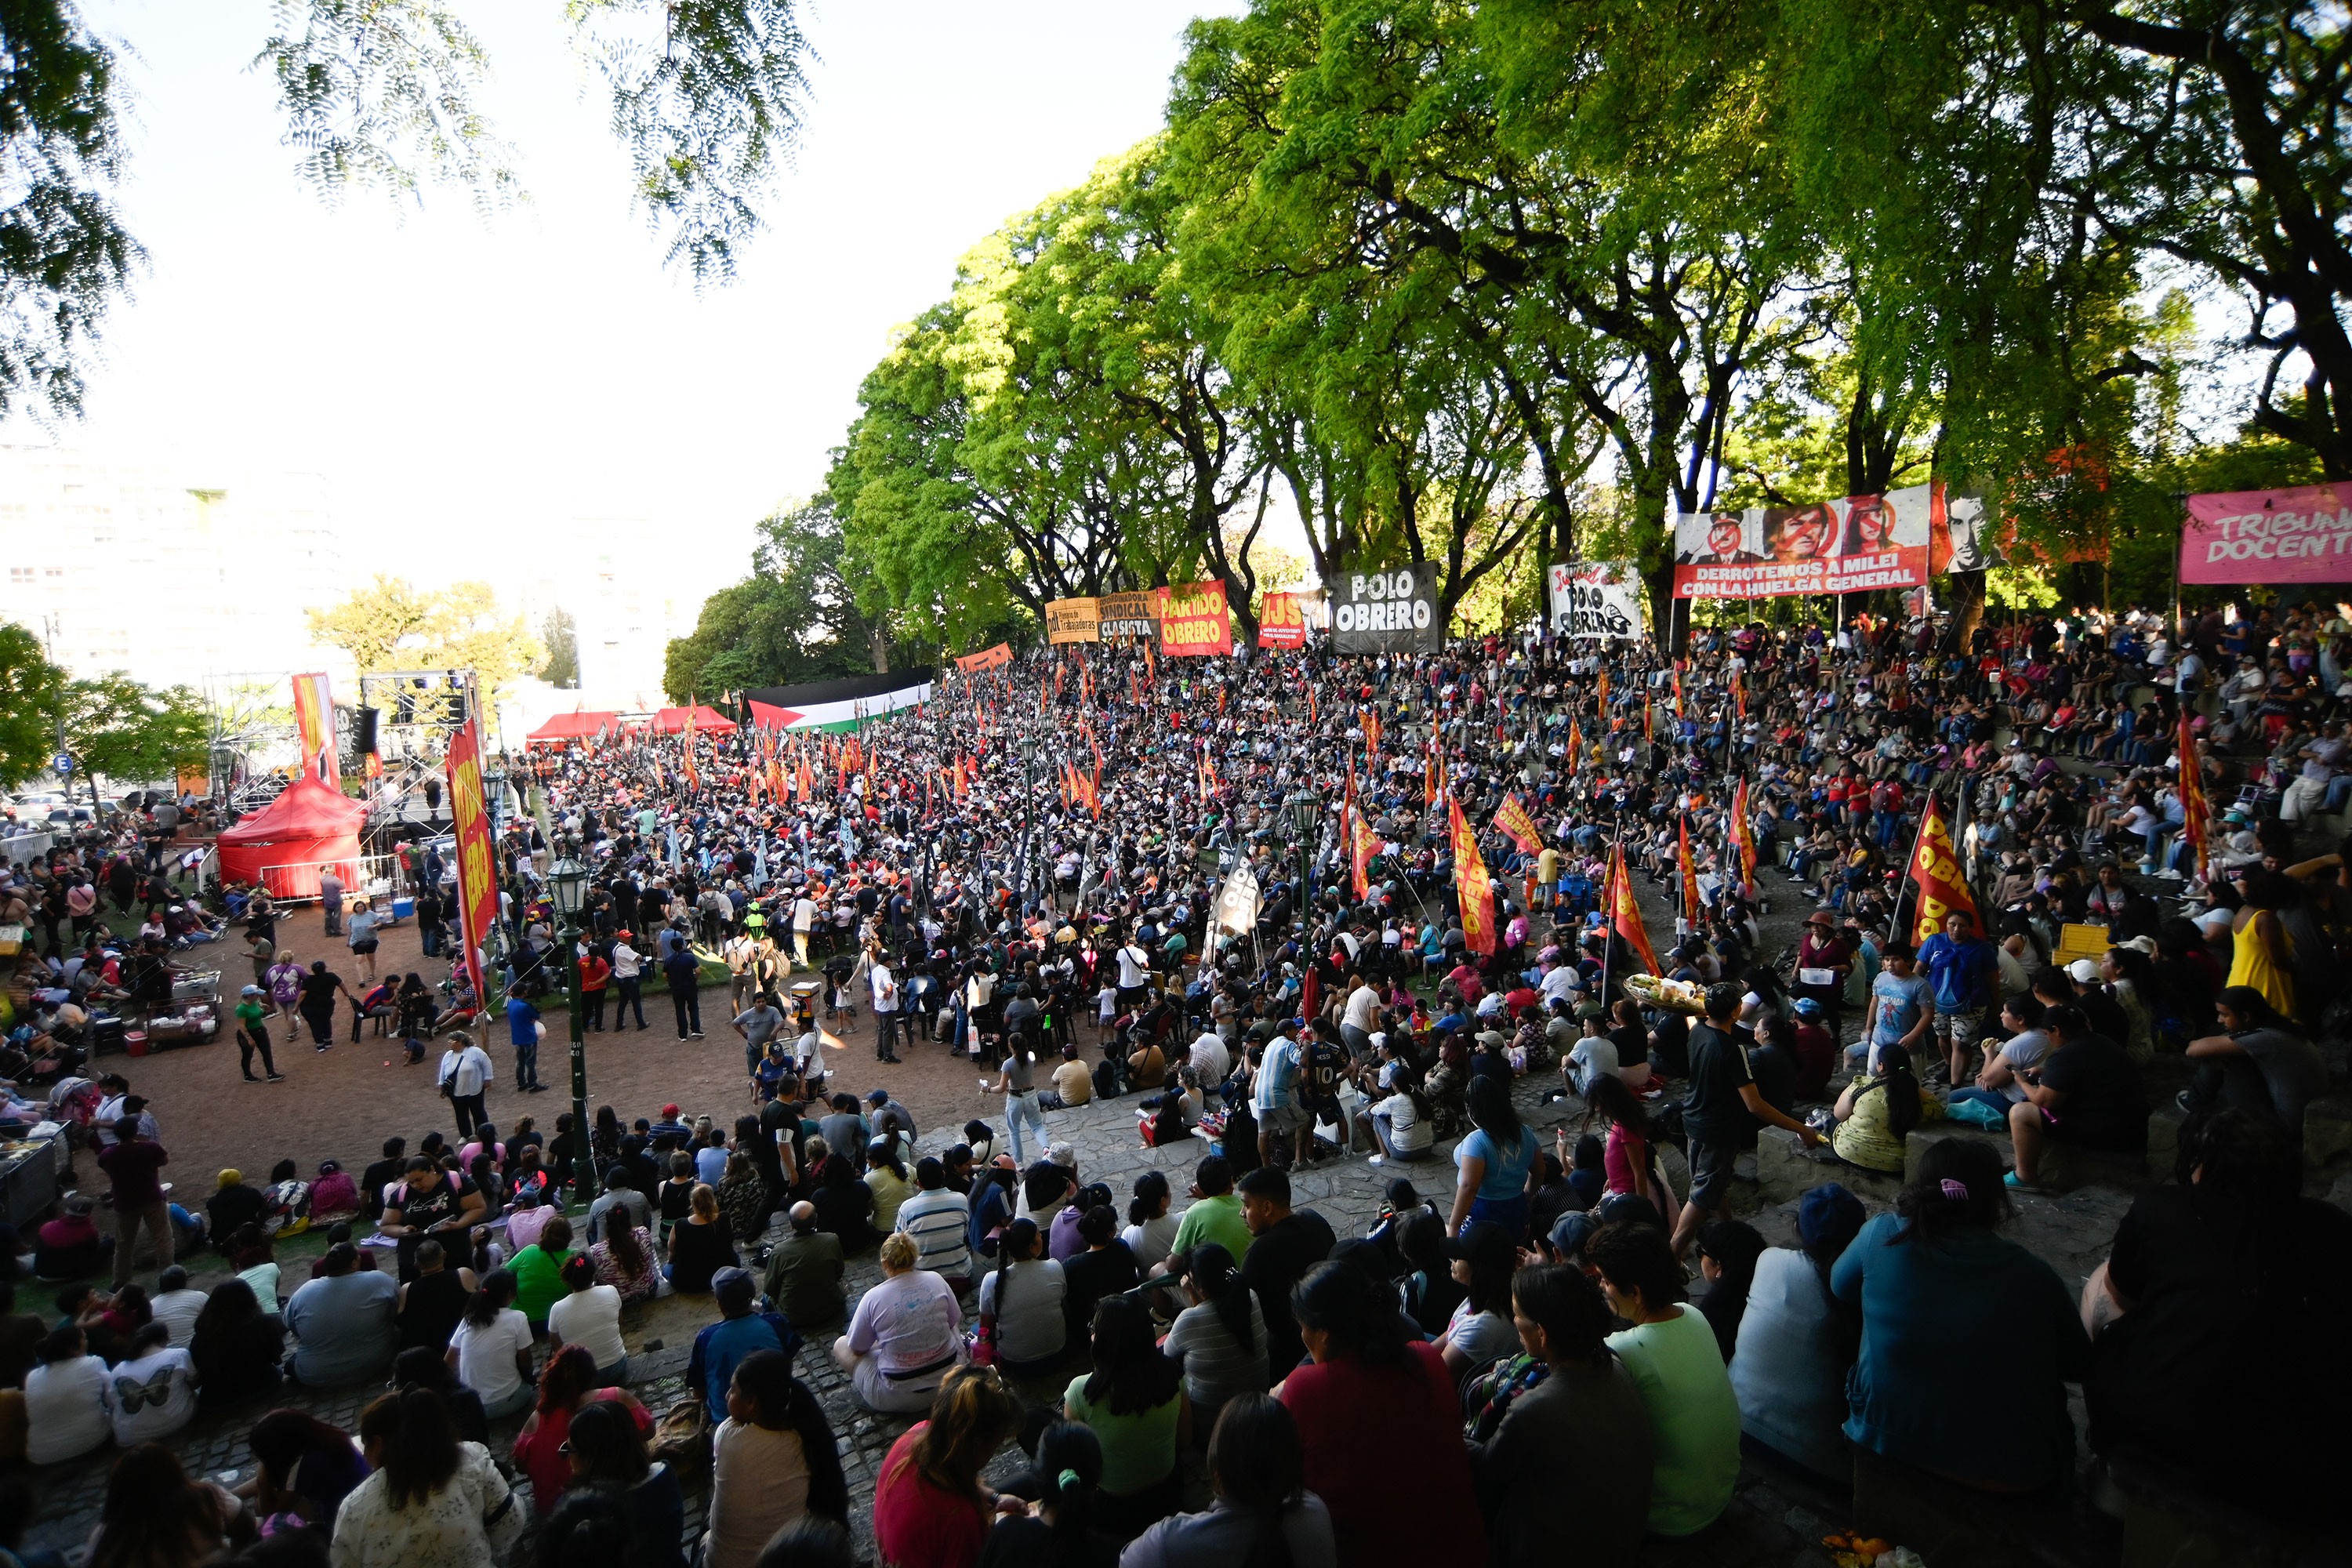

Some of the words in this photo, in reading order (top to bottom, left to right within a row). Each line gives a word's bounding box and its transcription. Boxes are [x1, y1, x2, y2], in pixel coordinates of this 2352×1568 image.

[2214, 507, 2352, 539] TRIBUN
[2206, 532, 2352, 563] DOCENT
[1697, 562, 1823, 581] DERROTEMOS
[1827, 560, 1840, 575] A
[1844, 553, 1899, 573] MILEI
[1352, 570, 1414, 602] POLO
[1682, 583, 1716, 596] CON
[1720, 582, 1744, 596] LA
[1747, 578, 1822, 596] HUELGA
[1825, 568, 1915, 590] GENERAL
[1099, 593, 1149, 605] COORDINADORA
[1099, 602, 1150, 620] SINDICAL
[1160, 591, 1222, 619] PARTIDO
[1261, 597, 1302, 626] UJS
[1047, 610, 1060, 639] pdt
[1060, 619, 1095, 633] Trabajadoras
[1102, 619, 1152, 637] CLASISTA
[1336, 599, 1431, 632] OBRERO
[1163, 619, 1221, 645] OBRERO
[57, 757, 68, 770] E
[1498, 809, 1541, 850] OBRERO
[1224, 855, 1249, 908] POLO
[1316, 1066, 1334, 1084] 10
